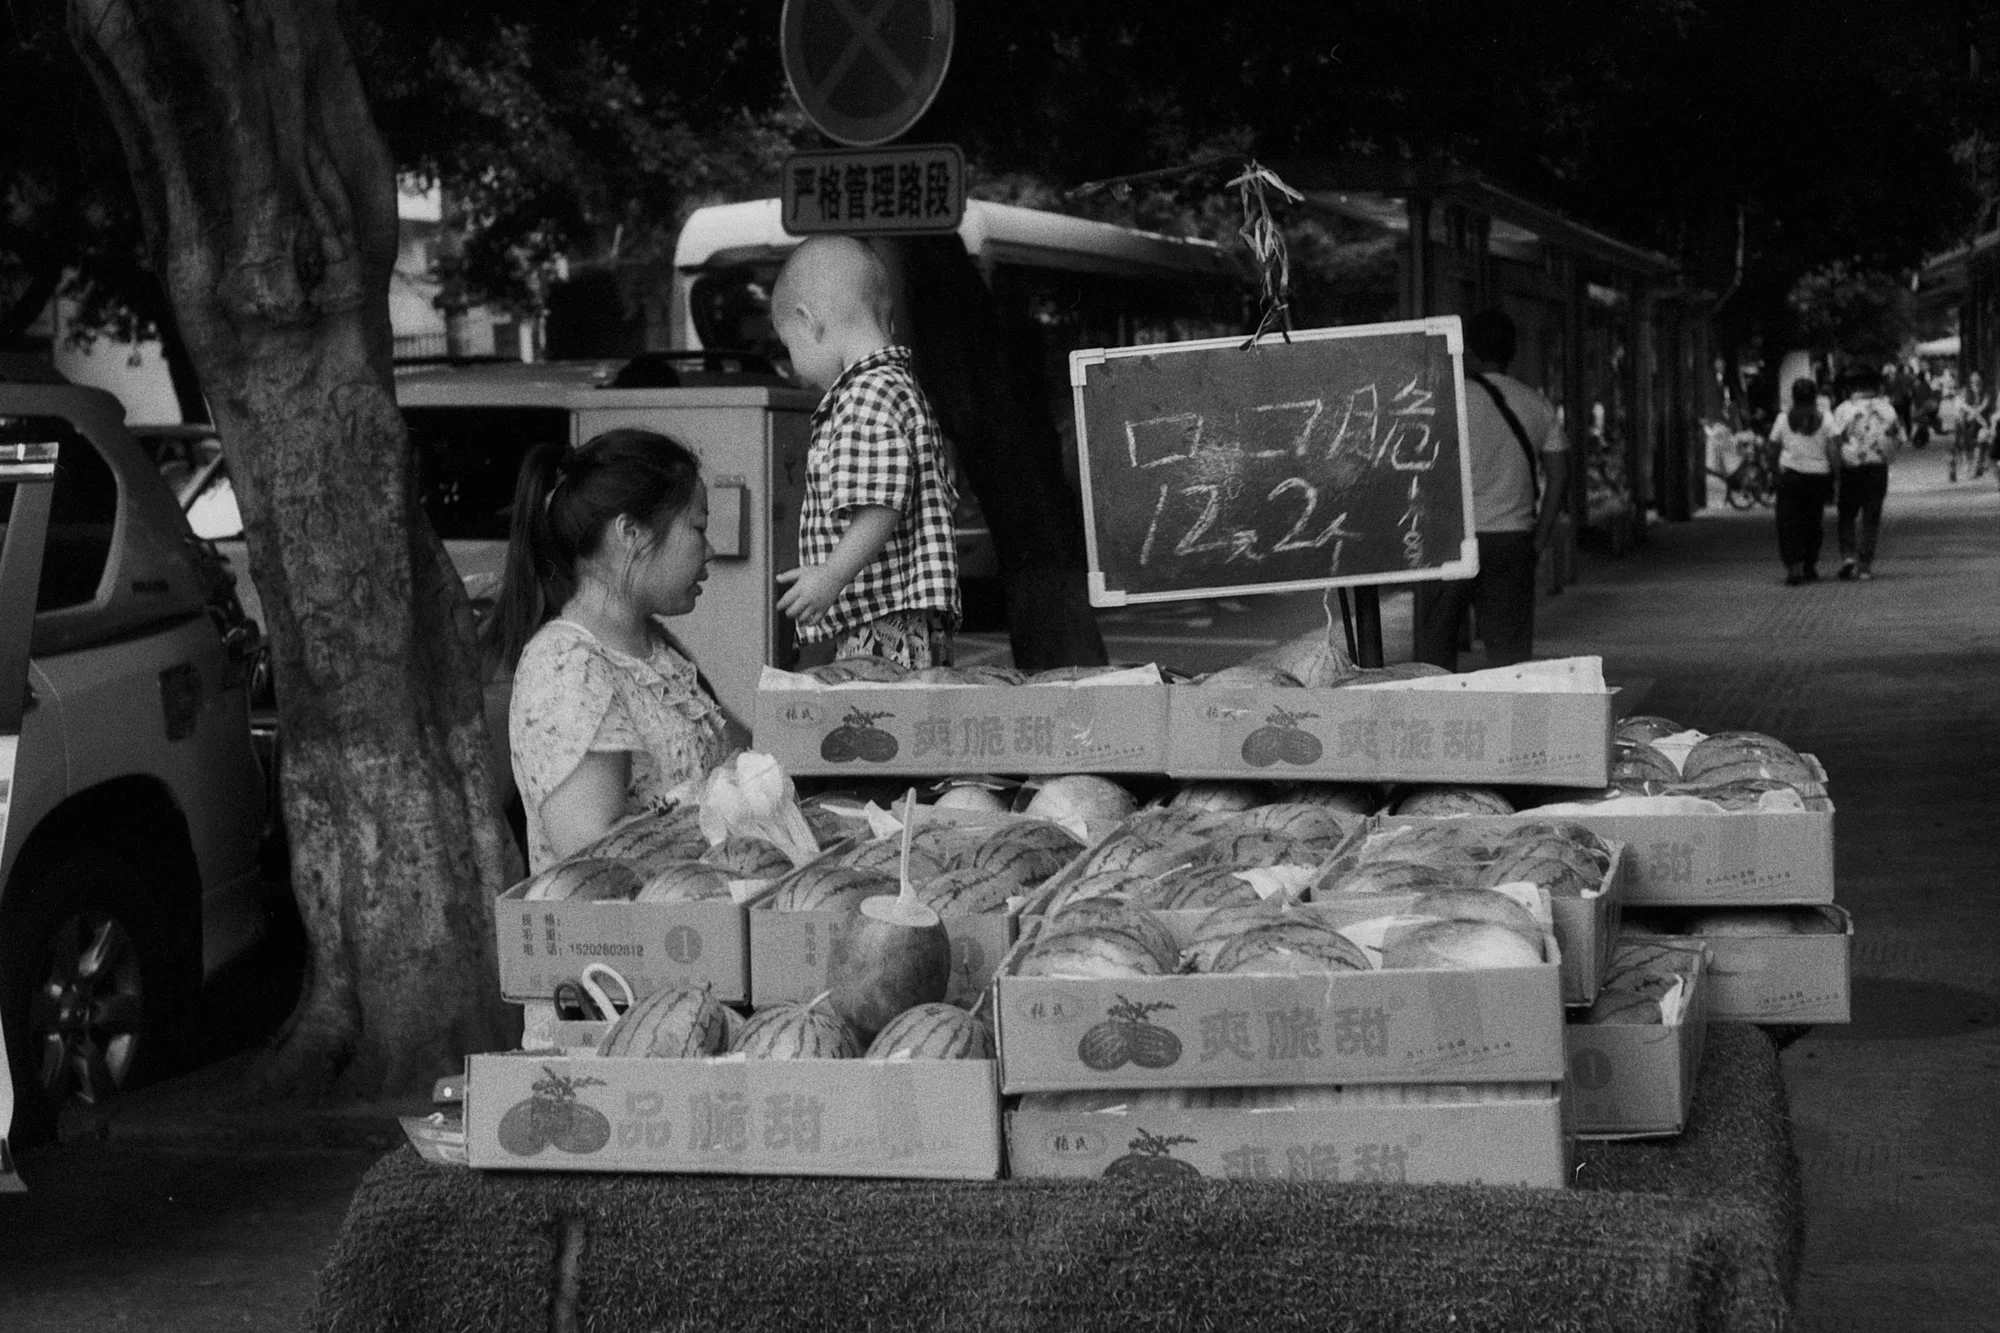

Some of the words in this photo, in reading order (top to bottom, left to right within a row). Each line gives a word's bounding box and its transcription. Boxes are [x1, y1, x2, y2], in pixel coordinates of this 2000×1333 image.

[792, 160, 950, 221] 严格管理路段
[911, 714, 1056, 758] 爽脆甜
[1336, 718, 1487, 760] 爽脆甜
[1199, 1006, 1391, 1061] 爽脆甜
